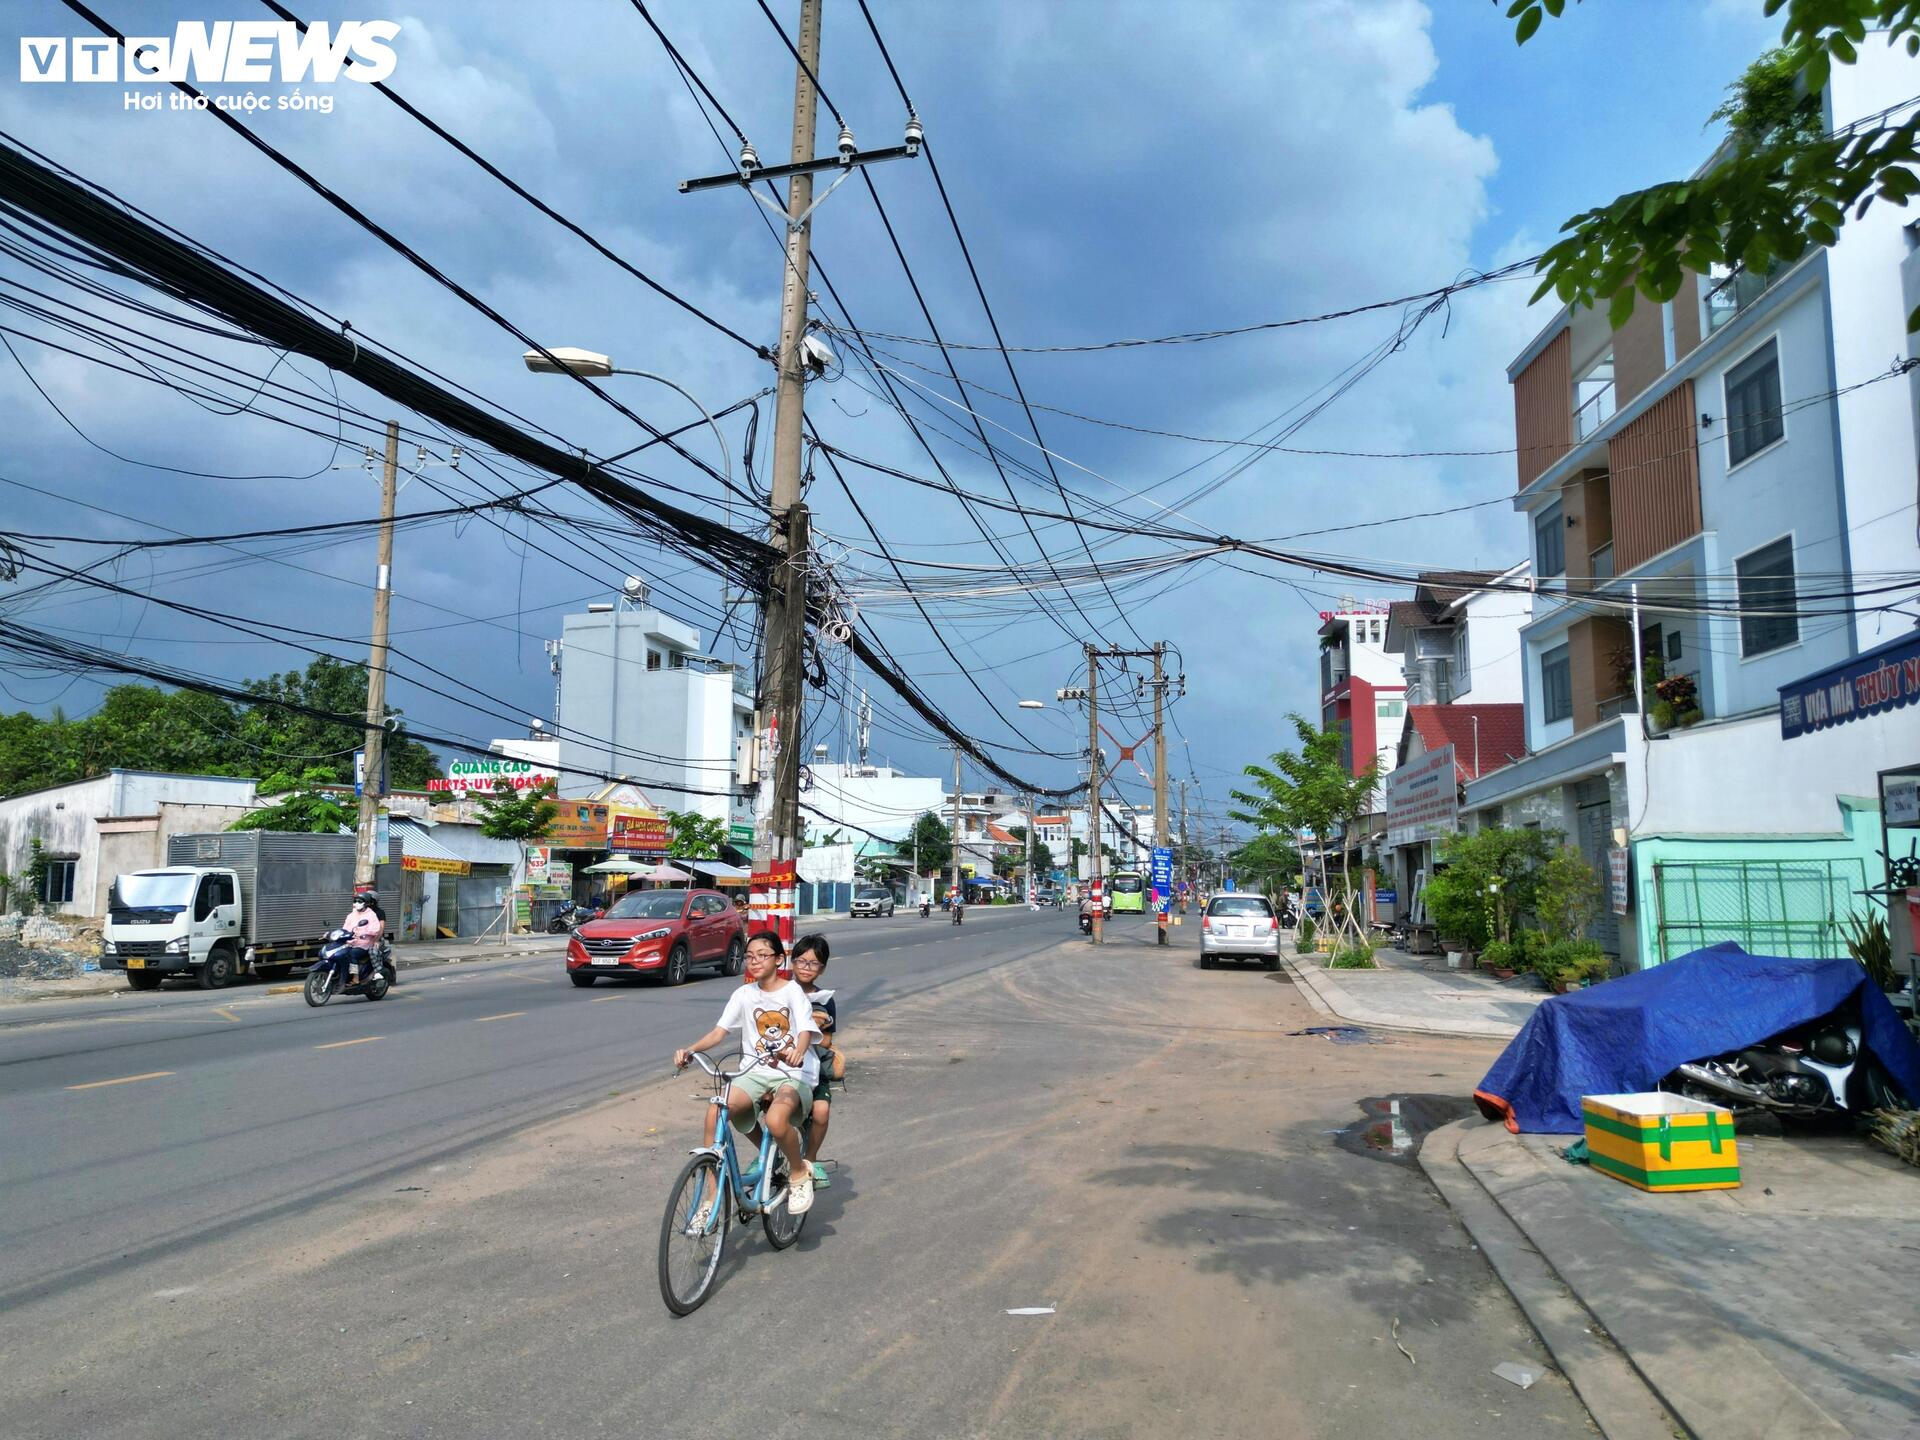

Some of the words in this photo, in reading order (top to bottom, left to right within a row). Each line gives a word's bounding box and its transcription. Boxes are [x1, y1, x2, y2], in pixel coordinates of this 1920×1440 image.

[1805, 688, 1828, 728] VỰA
[1829, 677, 1855, 717] MÍA
[1856, 659, 1900, 708] THỦY
